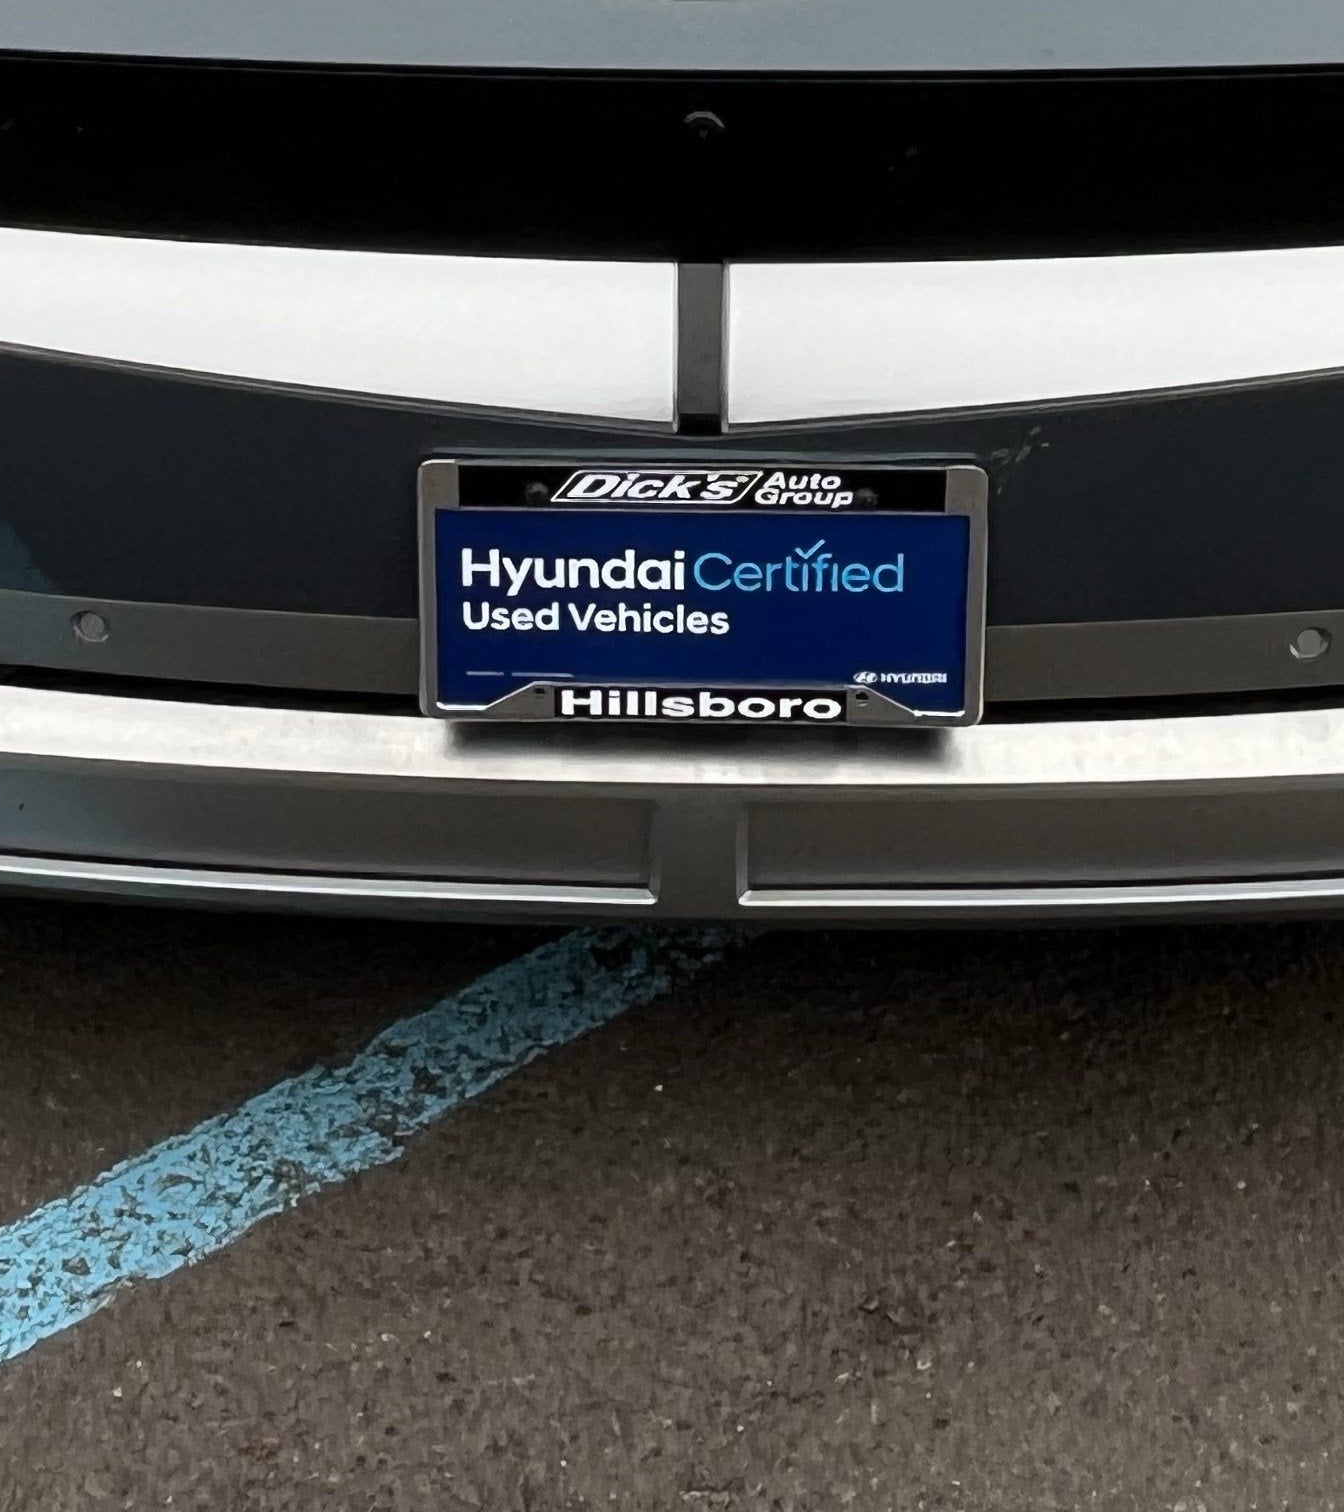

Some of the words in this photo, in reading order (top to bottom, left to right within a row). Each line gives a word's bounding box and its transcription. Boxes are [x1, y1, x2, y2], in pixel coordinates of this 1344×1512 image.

[762, 471, 842, 490] Auto
[754, 487, 854, 509] Group
[460, 548, 686, 596] Hyundai
[693, 539, 905, 594] Certified
[461, 601, 558, 632] Used
[568, 602, 730, 635] Vehicles
[560, 688, 842, 720] Hillsboro
